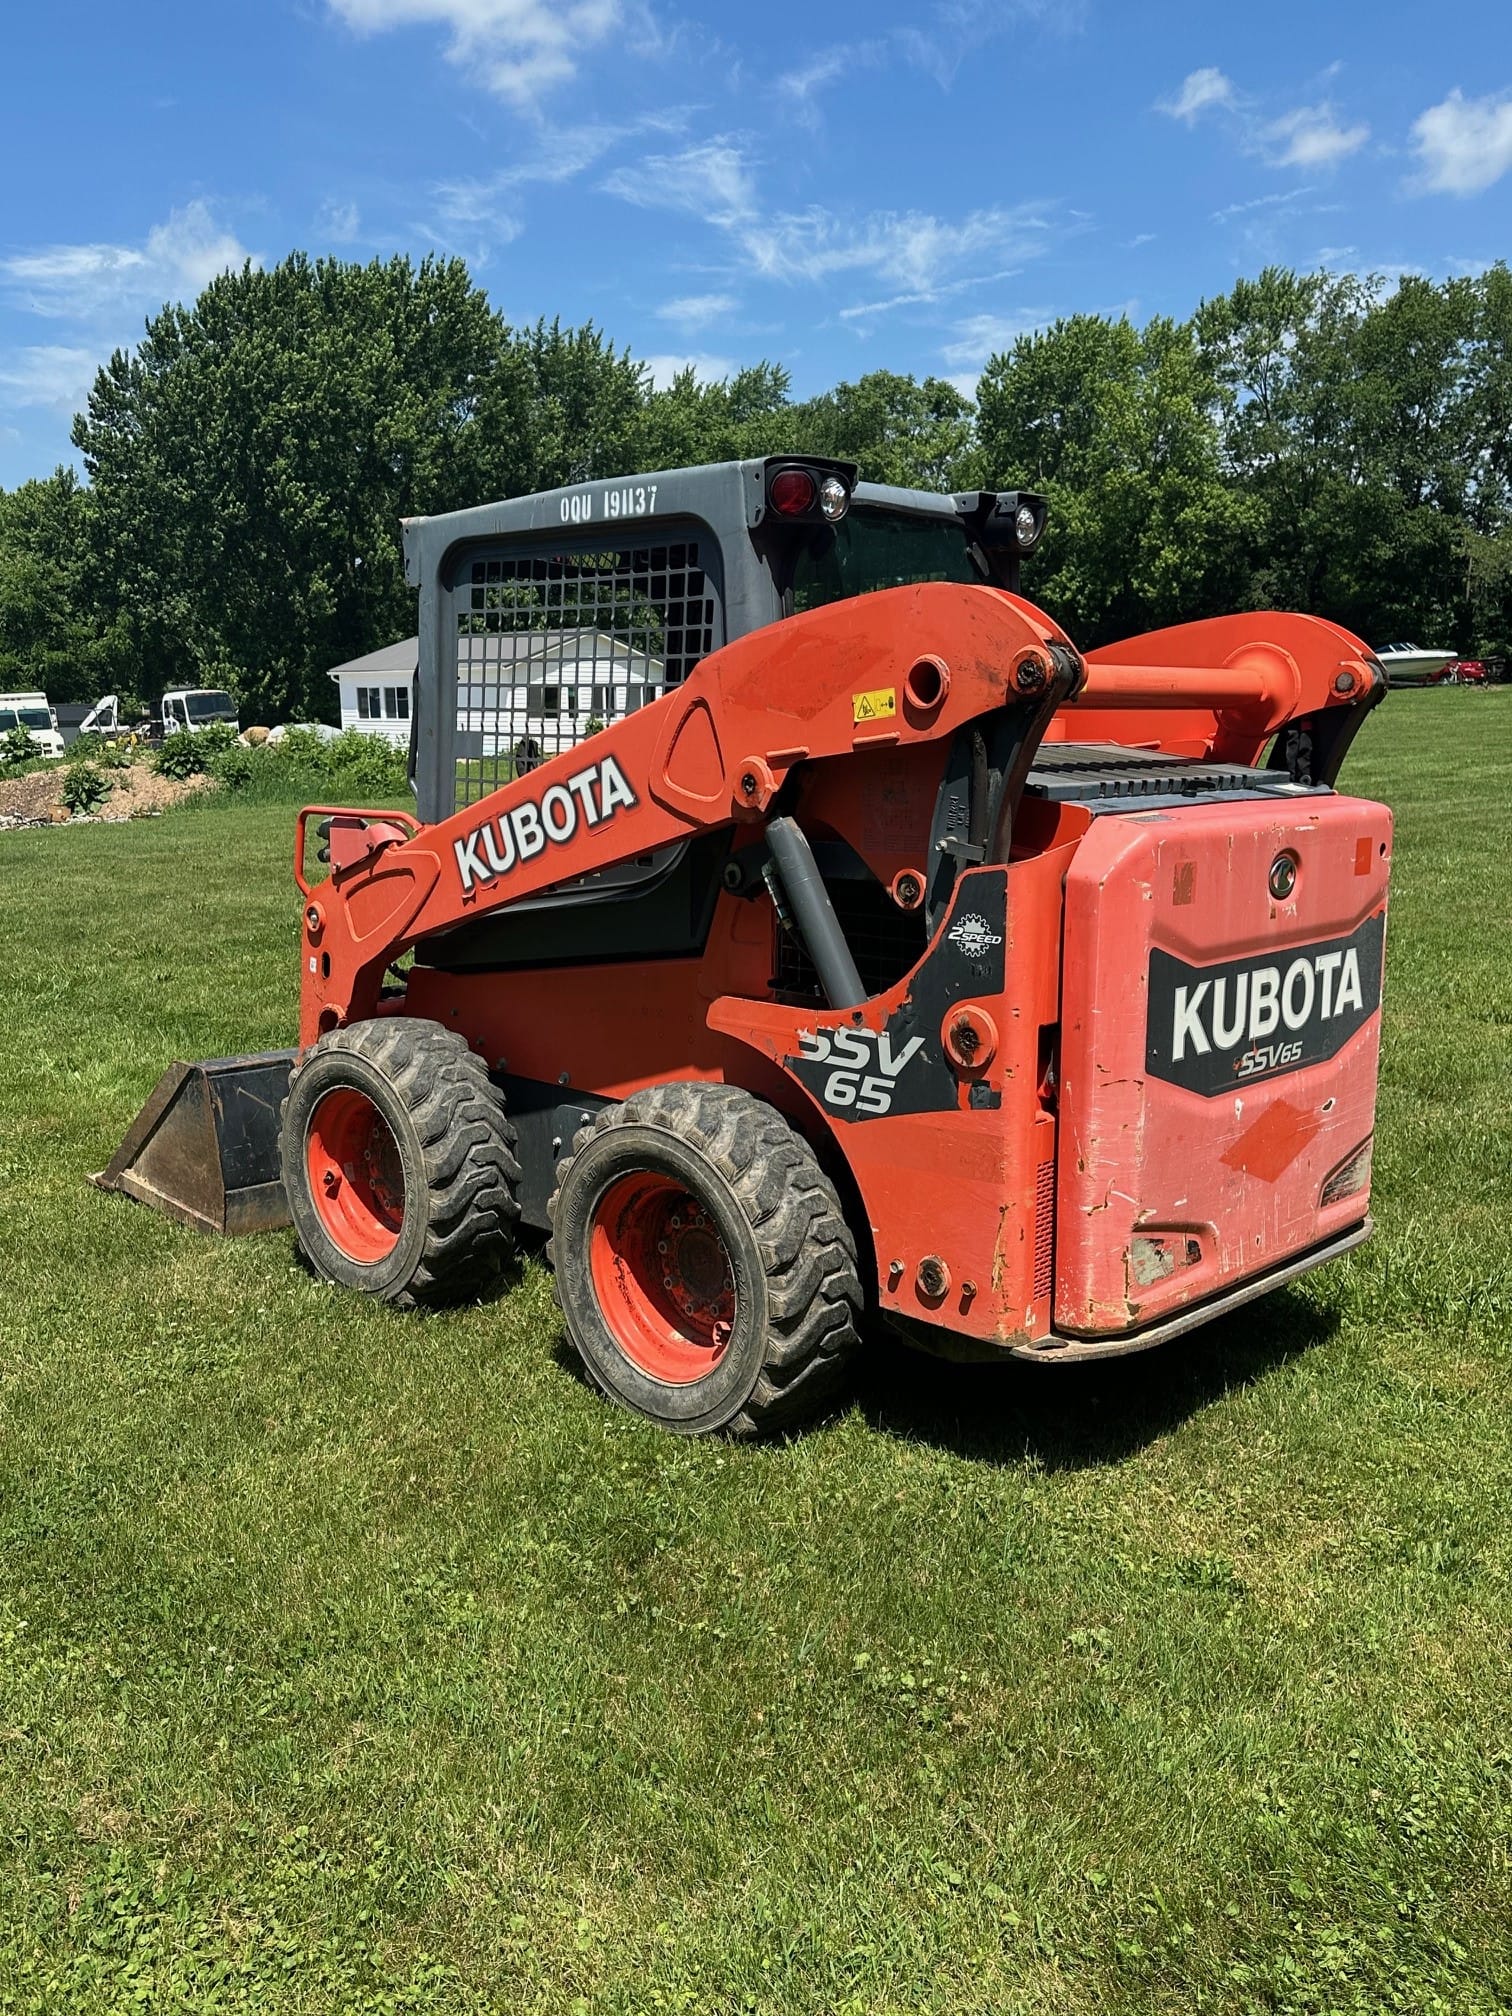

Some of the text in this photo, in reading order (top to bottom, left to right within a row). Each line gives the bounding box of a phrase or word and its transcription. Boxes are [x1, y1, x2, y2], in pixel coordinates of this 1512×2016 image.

[453, 755, 636, 890] KUBOTA
[1171, 947, 1364, 1063] KUBOTA
[823, 1070, 896, 1114] 65
[1237, 1040, 1304, 1078] SSV65
